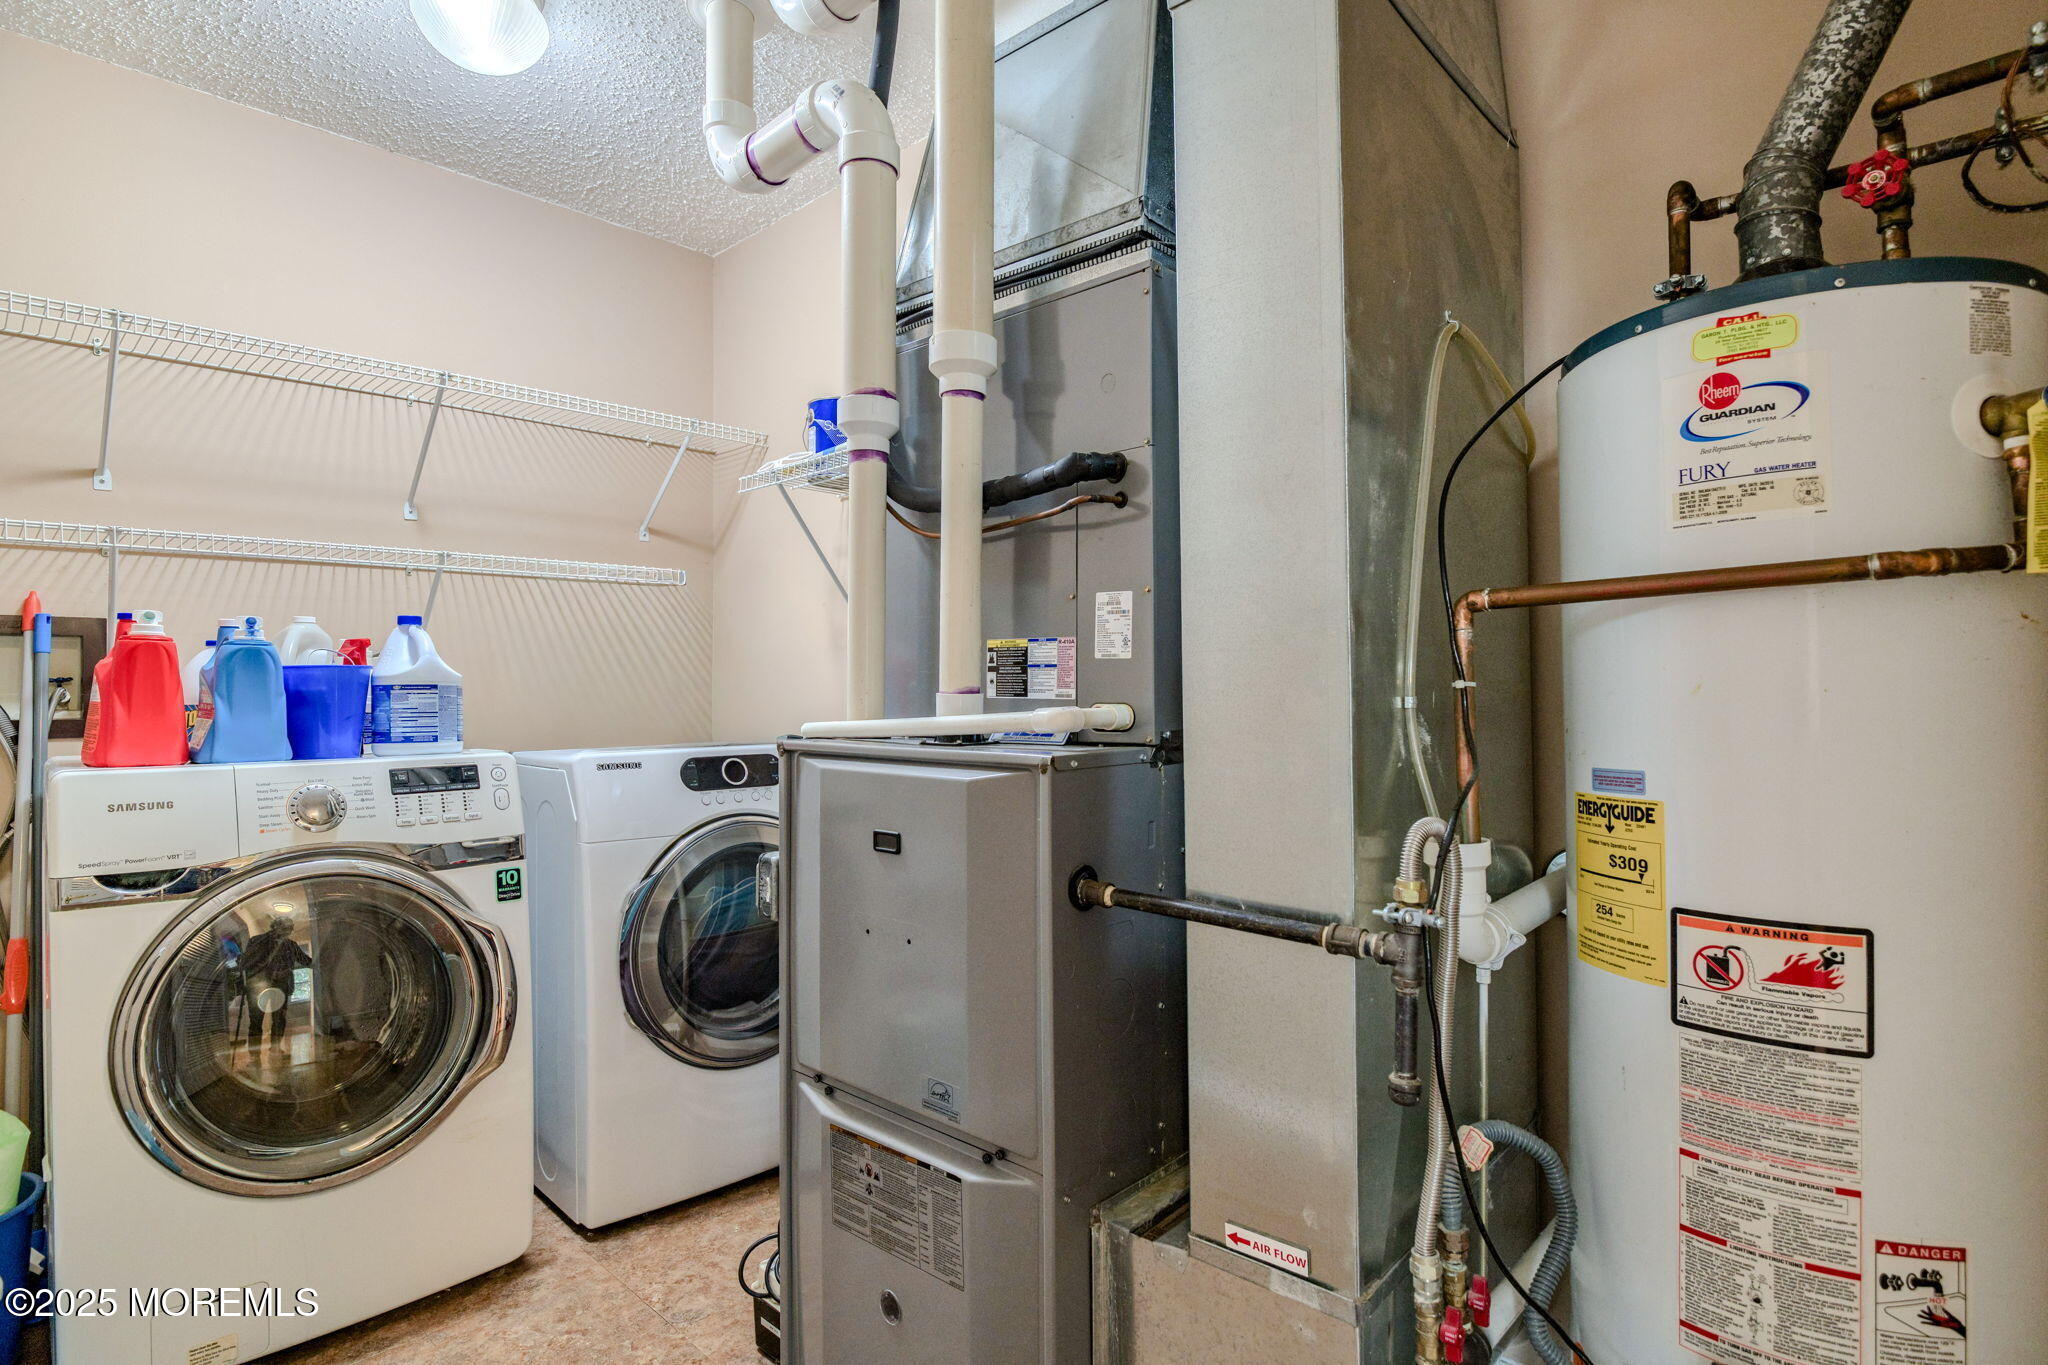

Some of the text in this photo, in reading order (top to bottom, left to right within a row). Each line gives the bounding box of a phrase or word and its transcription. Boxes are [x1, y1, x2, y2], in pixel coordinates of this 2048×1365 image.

[1722, 314, 1764, 326] CALL
[1702, 376, 1740, 404] Rheem
[1700, 403, 1775, 423] GUARDIAN
[1747, 416, 1776, 424] SYSTEM
[1791, 461, 1816, 469] HEATER
[1679, 461, 1730, 484] FURY
[597, 762, 642, 771] SAMSUNG
[107, 801, 174, 813] SAMSUNG
[1578, 799, 1655, 823] ENERGYGUIDE
[1609, 854, 1648, 873] $309
[499, 870, 518, 885] 10
[1596, 904, 1613, 916] 254
[1741, 926, 1809, 942] WARNING
[1761, 986, 1825, 1000] Flammable Vapors
[1750, 999, 1785, 1010] EXPLOSION
[1786, 1005, 1813, 1013] HAZARD
[1752, 1006, 1773, 1014] serious
[1775, 1009, 1791, 1017] injury
[1701, 1156, 1711, 1164] FOR
[1713, 1160, 1728, 1168] YOUR
[1730, 1165, 1751, 1175] SAFETY
[1253, 1242, 1306, 1268] AIR FLOW
[1898, 1246, 1961, 1259] DANGER
